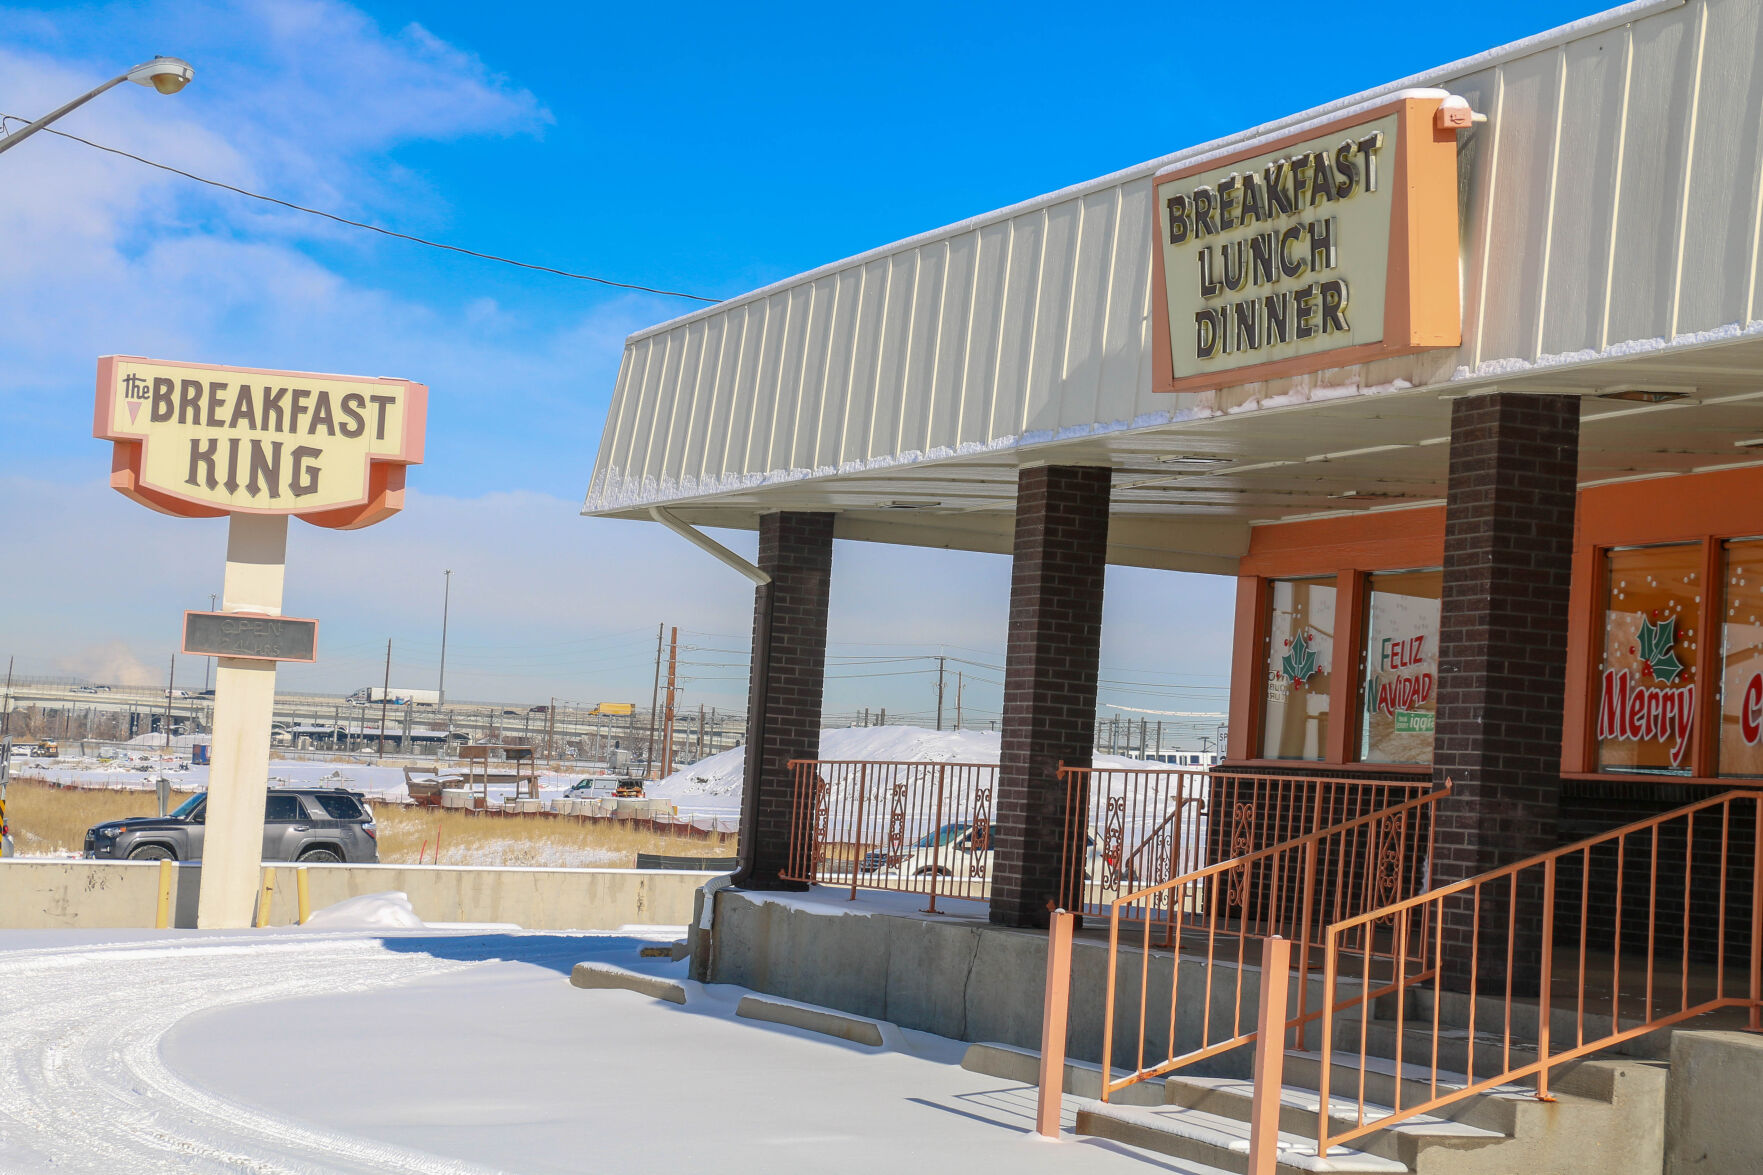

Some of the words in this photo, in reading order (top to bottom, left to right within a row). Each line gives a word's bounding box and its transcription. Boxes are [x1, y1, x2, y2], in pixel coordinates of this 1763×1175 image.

[1167, 130, 1384, 245] BREAKFAST
[1198, 217, 1337, 298] LUNCH
[1194, 278, 1350, 360] DINNER
[122, 373, 150, 400] the
[149, 376, 397, 441] BREAKFAST
[184, 438, 323, 499] KING
[221, 619, 282, 635] OPEN
[1380, 634, 1425, 672] FELIZ
[1597, 667, 1695, 768] Merry
